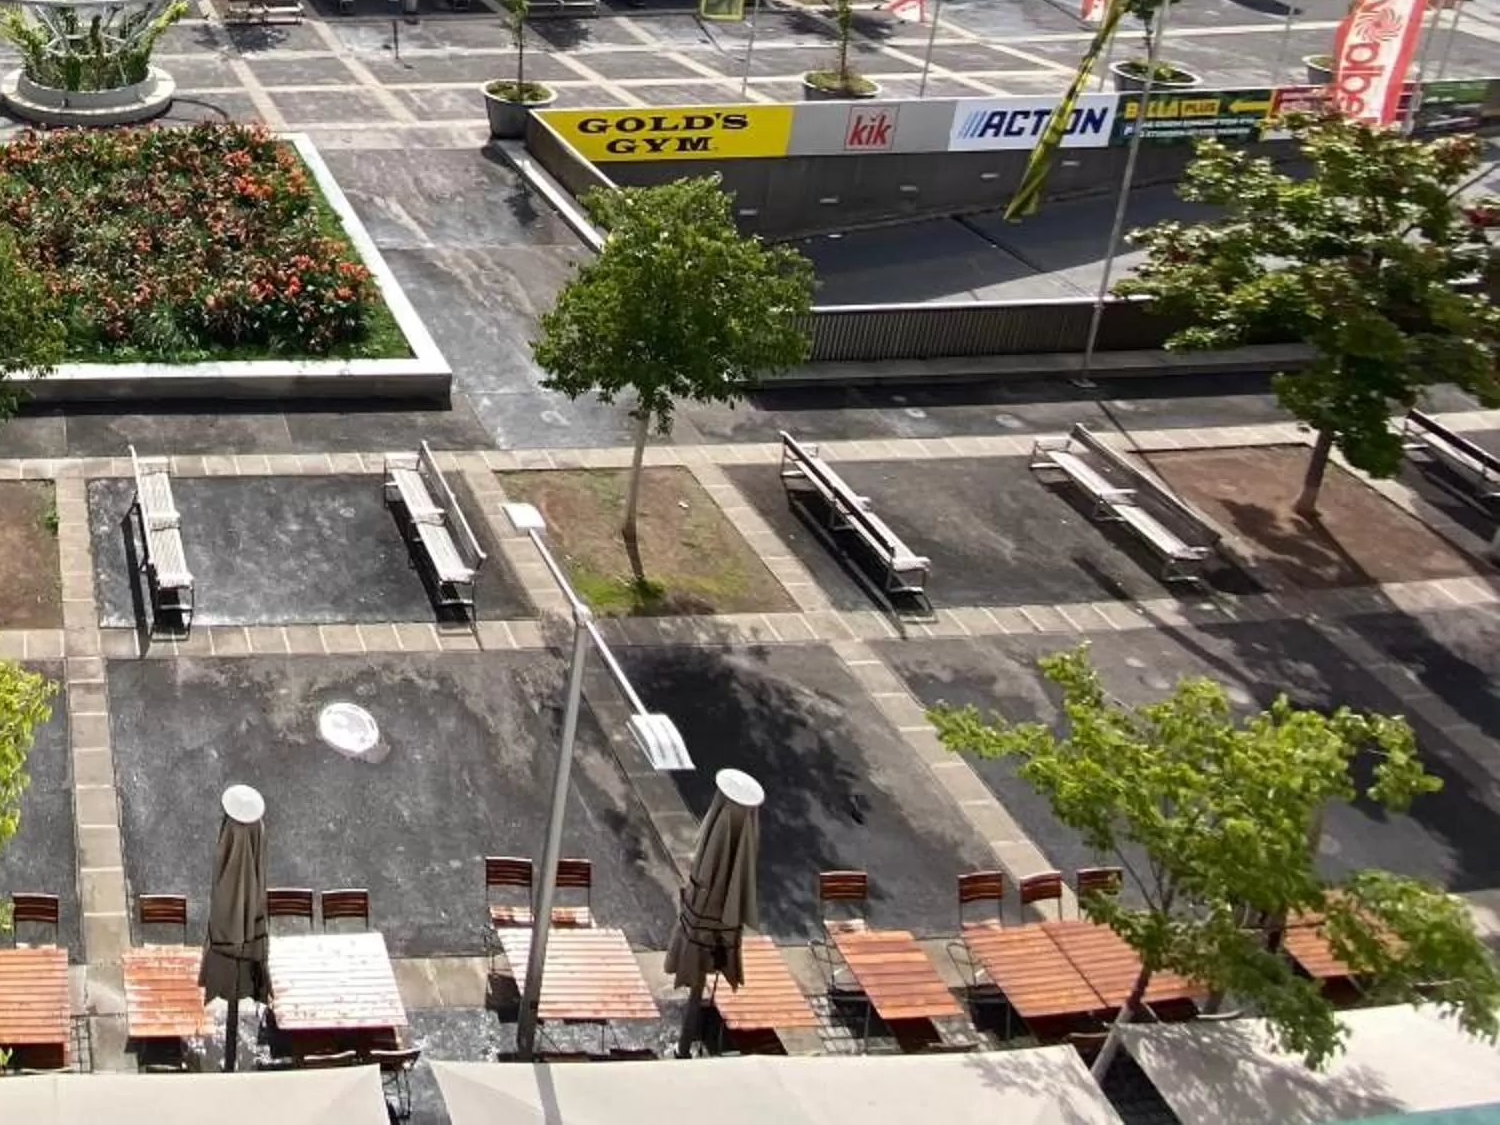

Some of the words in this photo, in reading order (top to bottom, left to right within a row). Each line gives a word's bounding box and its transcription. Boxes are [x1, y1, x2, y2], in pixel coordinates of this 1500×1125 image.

[1124, 99, 1179, 120] BLLA
[578, 113, 749, 134] GOLD'S
[977, 106, 1109, 138] ACTON
[606, 136, 711, 155] GYM
